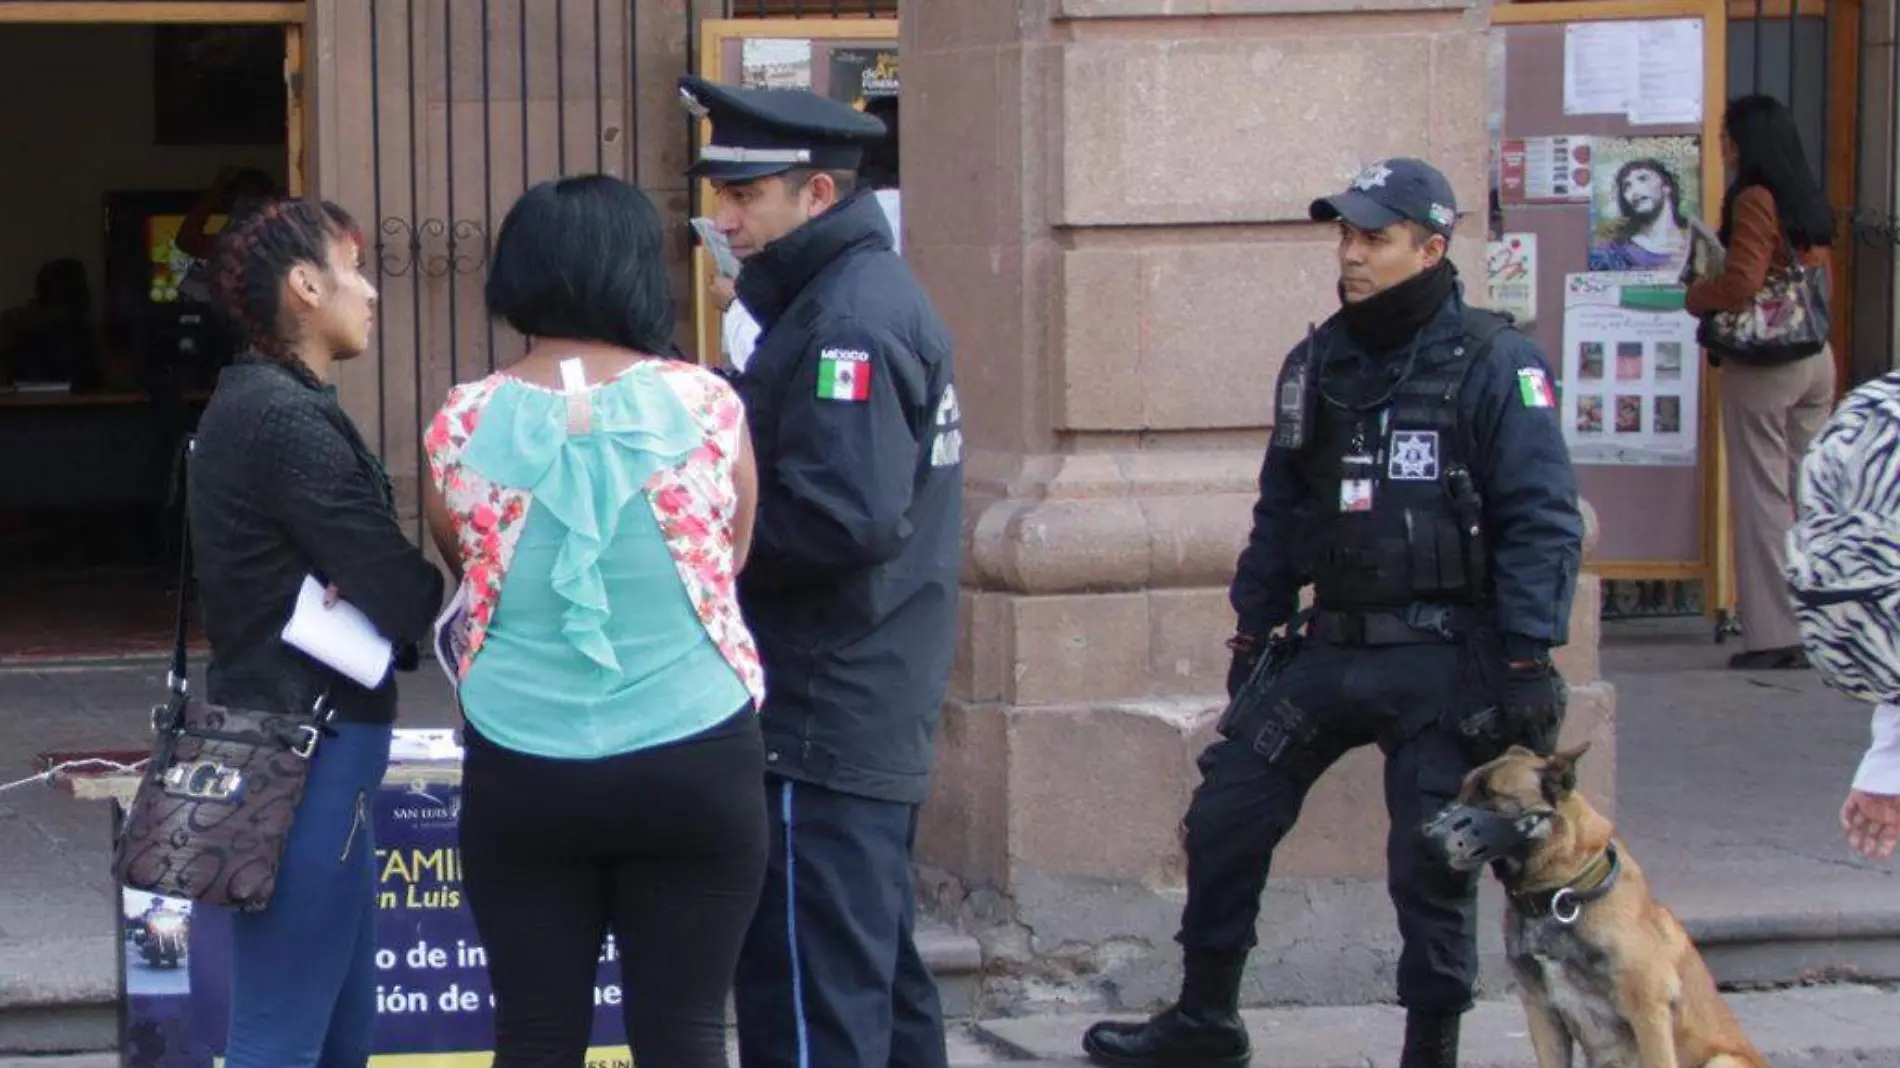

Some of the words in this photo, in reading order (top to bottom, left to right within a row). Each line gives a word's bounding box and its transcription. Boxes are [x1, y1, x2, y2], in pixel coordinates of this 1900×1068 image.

[393, 807, 418, 819] SAN
[421, 807, 448, 819] LUIS
[376, 891, 397, 909] n
[406, 883, 460, 909] Luis
[406, 940, 447, 968] de
[438, 983, 479, 1012] de
